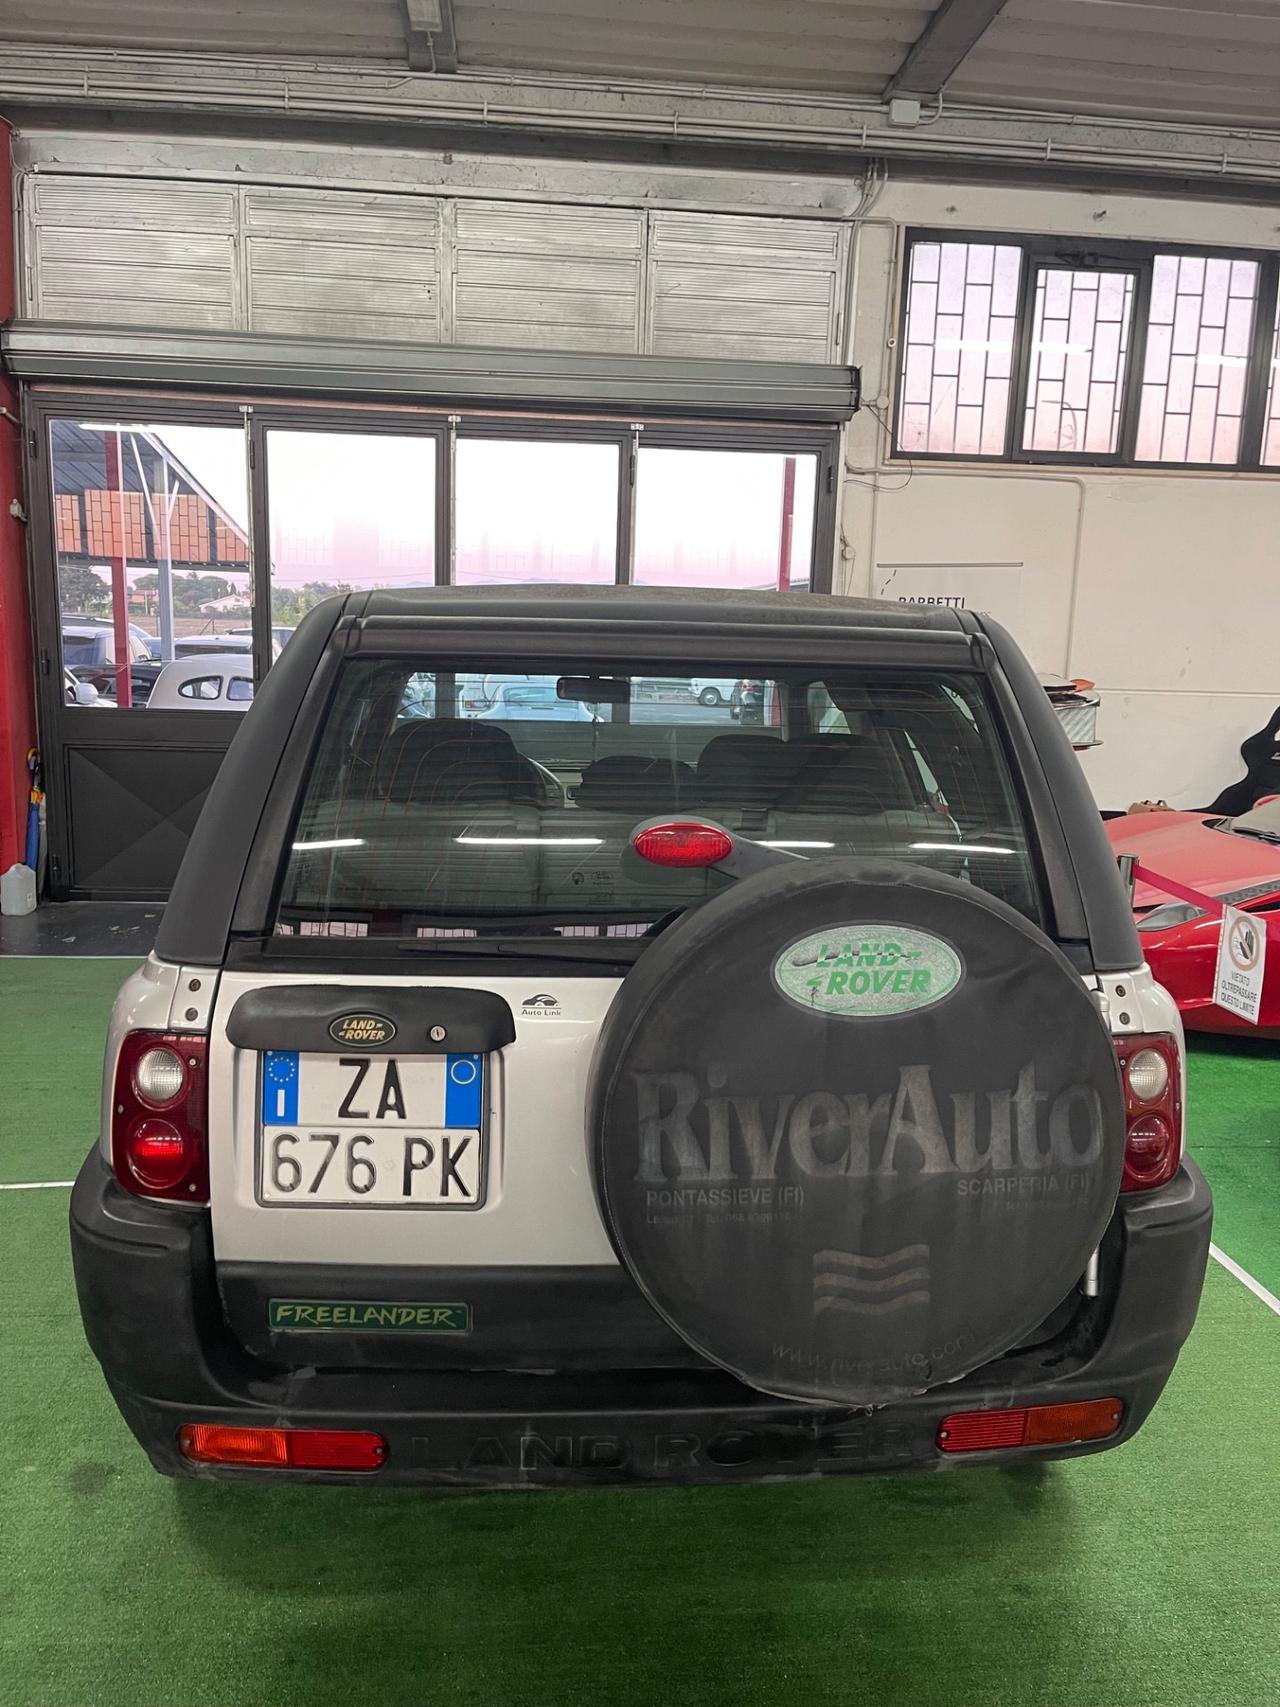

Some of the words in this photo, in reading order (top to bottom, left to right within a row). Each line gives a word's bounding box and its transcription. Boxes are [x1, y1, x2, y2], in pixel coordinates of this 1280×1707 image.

[816, 943, 901, 968] LAND
[826, 969, 932, 995] ROVER
[1231, 971, 1250, 987] VIETATO
[1221, 980, 1258, 1003] OLTREPASSARE
[343, 1019, 376, 1030] LAND
[345, 1029, 386, 1040] ROVER
[337, 1058, 407, 1120] ZA
[633, 1064, 1105, 1183] RiverAuto
[271, 1134, 377, 1194] 676
[402, 1136, 472, 1198] PK
[646, 1187, 772, 1207] PONTASSIEVE
[778, 1186, 805, 1208] (FI)
[276, 1305, 457, 1327] FREELANDER
[410, 1435, 631, 1471] LAND
